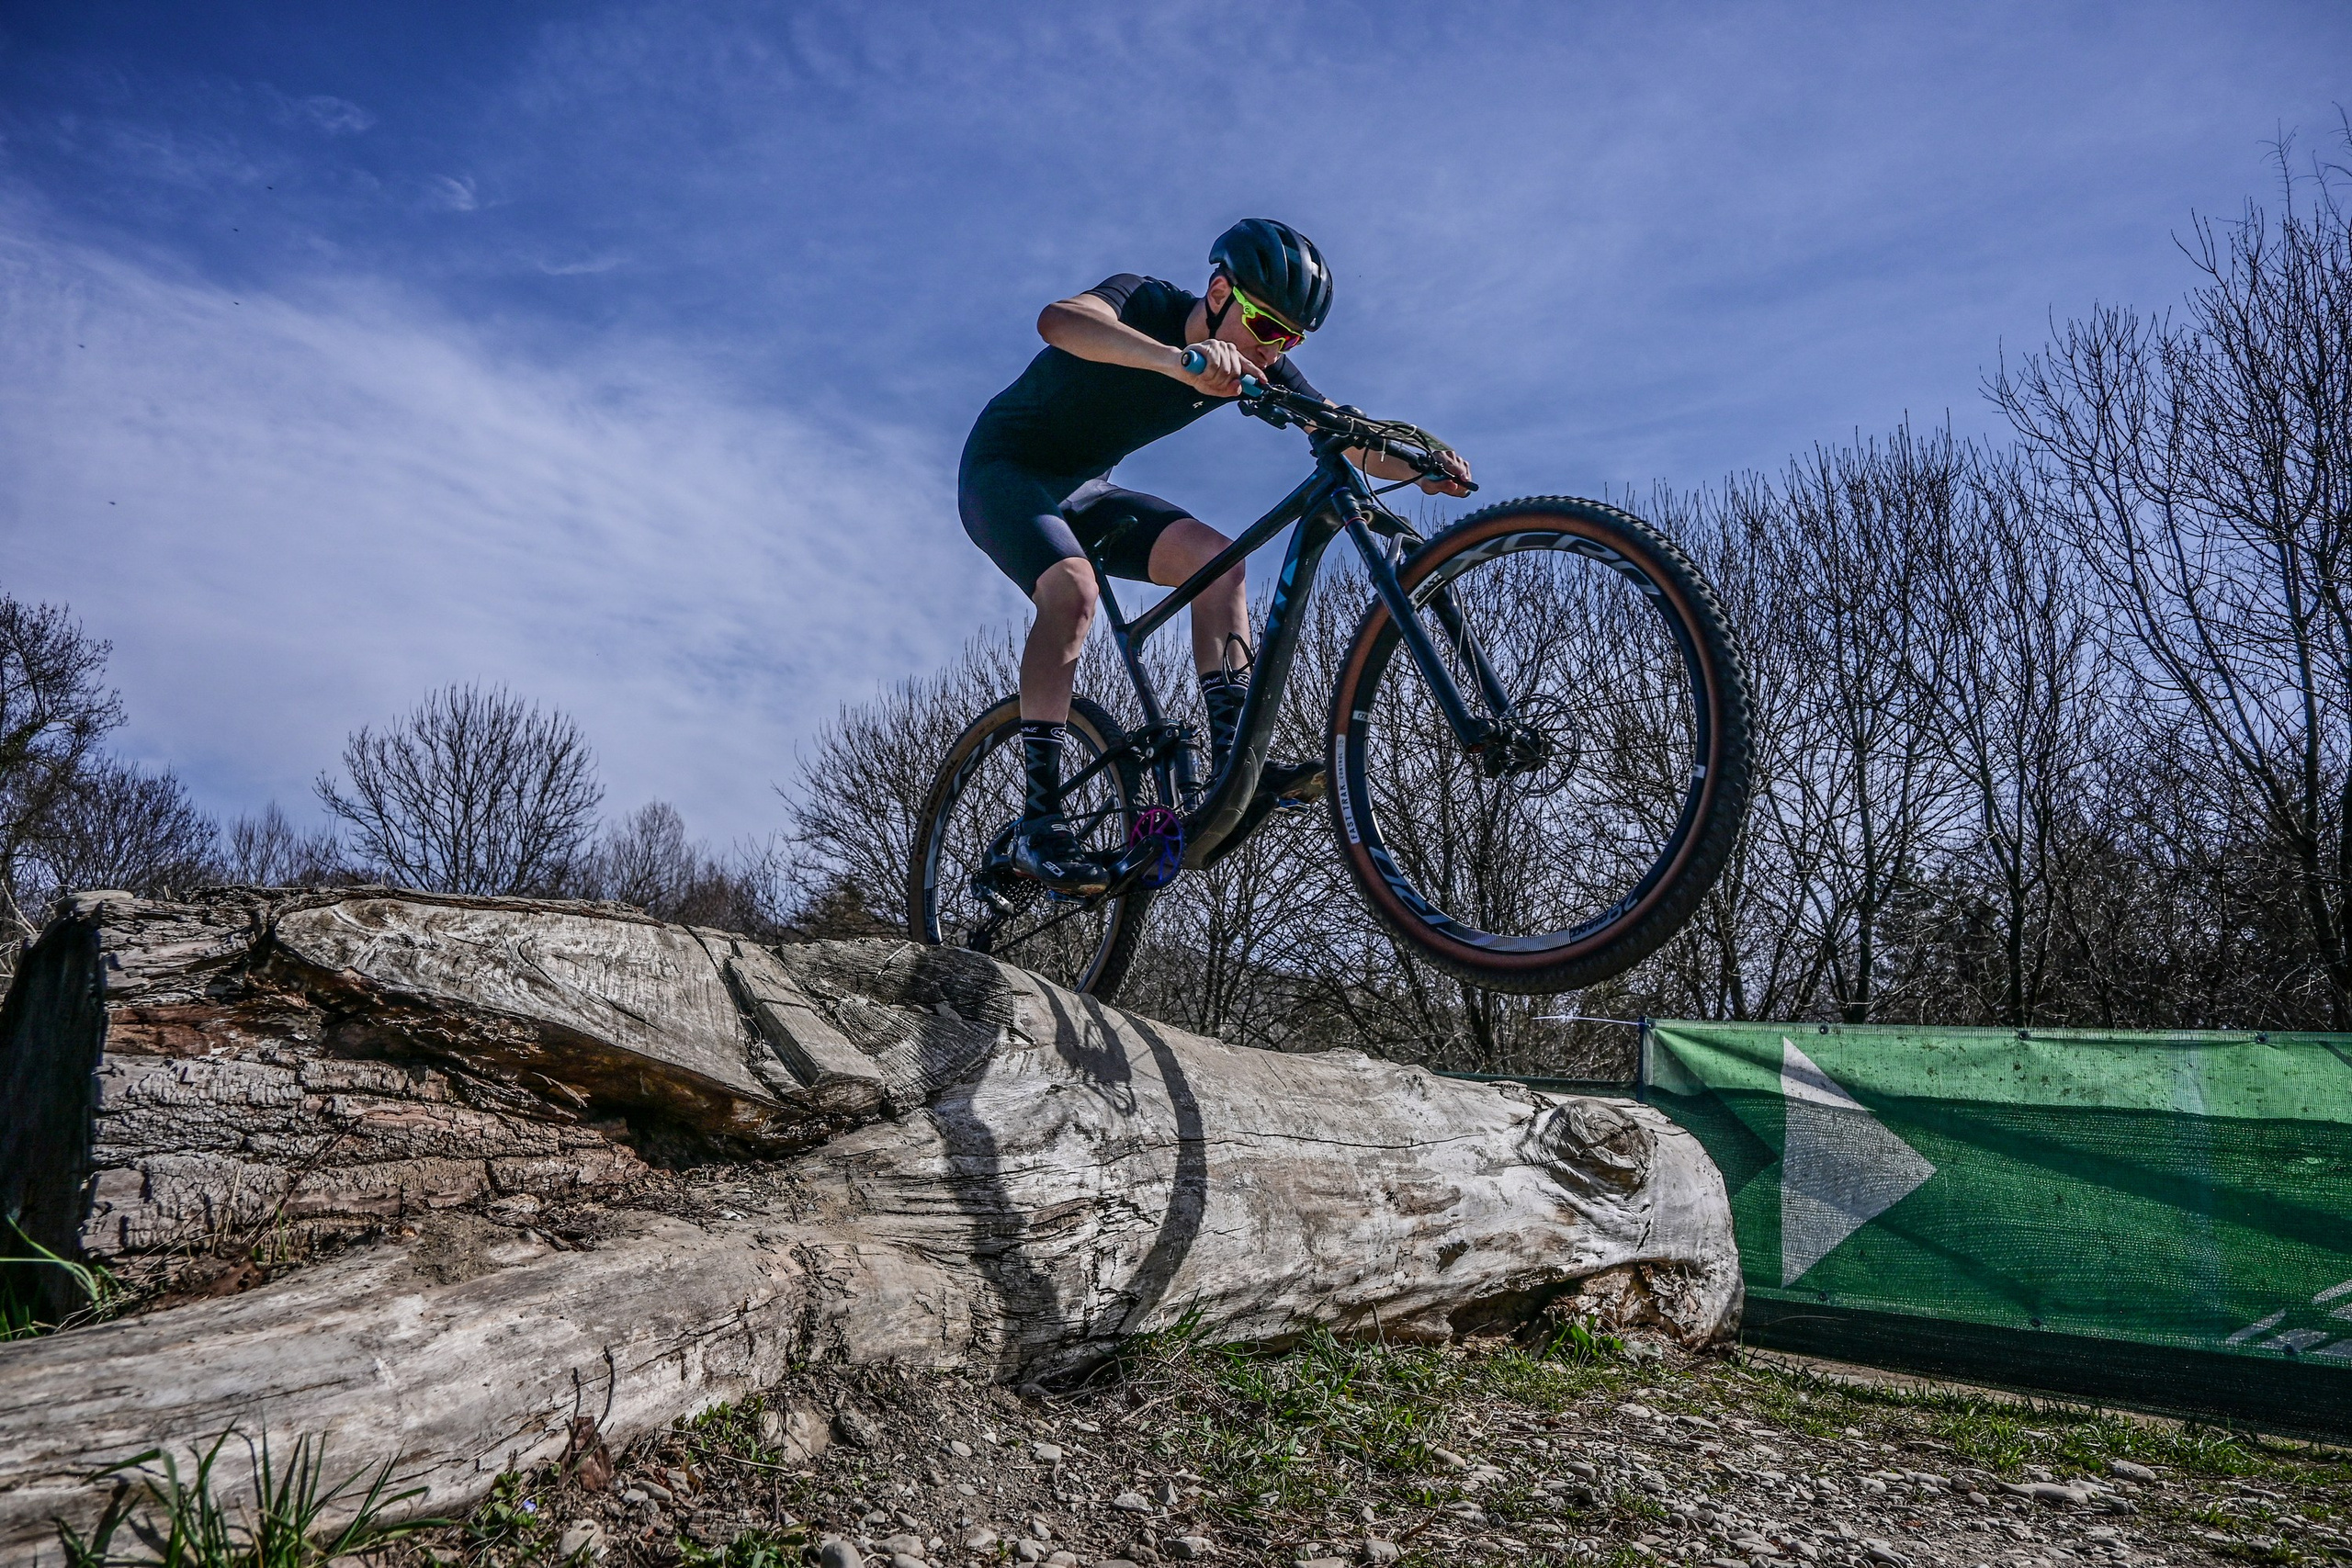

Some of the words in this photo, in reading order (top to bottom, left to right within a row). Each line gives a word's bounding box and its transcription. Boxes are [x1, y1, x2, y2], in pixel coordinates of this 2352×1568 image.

[927, 757, 959, 816] MEZCAL
[1339, 784, 1351, 810] TRAK
[1344, 816, 1358, 840] FAST
